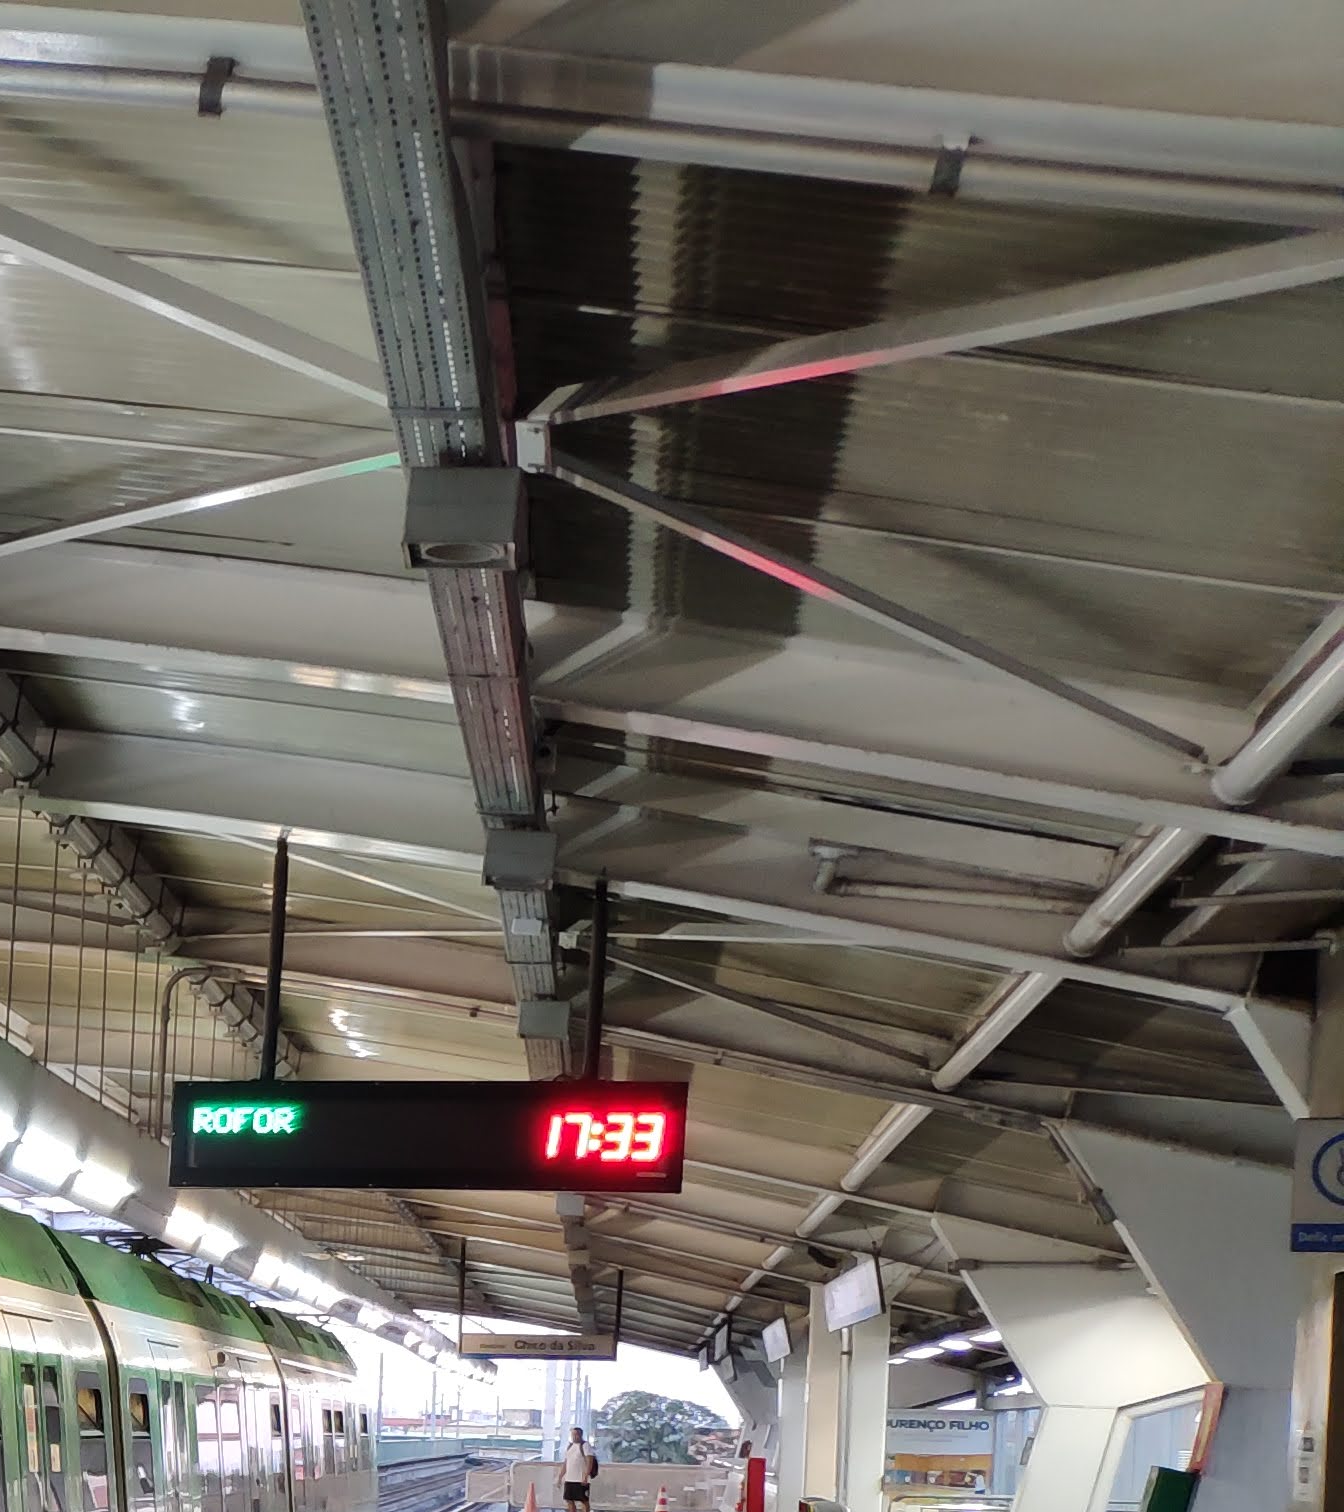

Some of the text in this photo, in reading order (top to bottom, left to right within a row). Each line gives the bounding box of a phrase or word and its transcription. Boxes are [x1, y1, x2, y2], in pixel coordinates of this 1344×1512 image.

[192, 1106, 298, 1134] ROFOR
[545, 1112, 665, 1162] 17:33
[949, 1420, 990, 1431] FILHO
